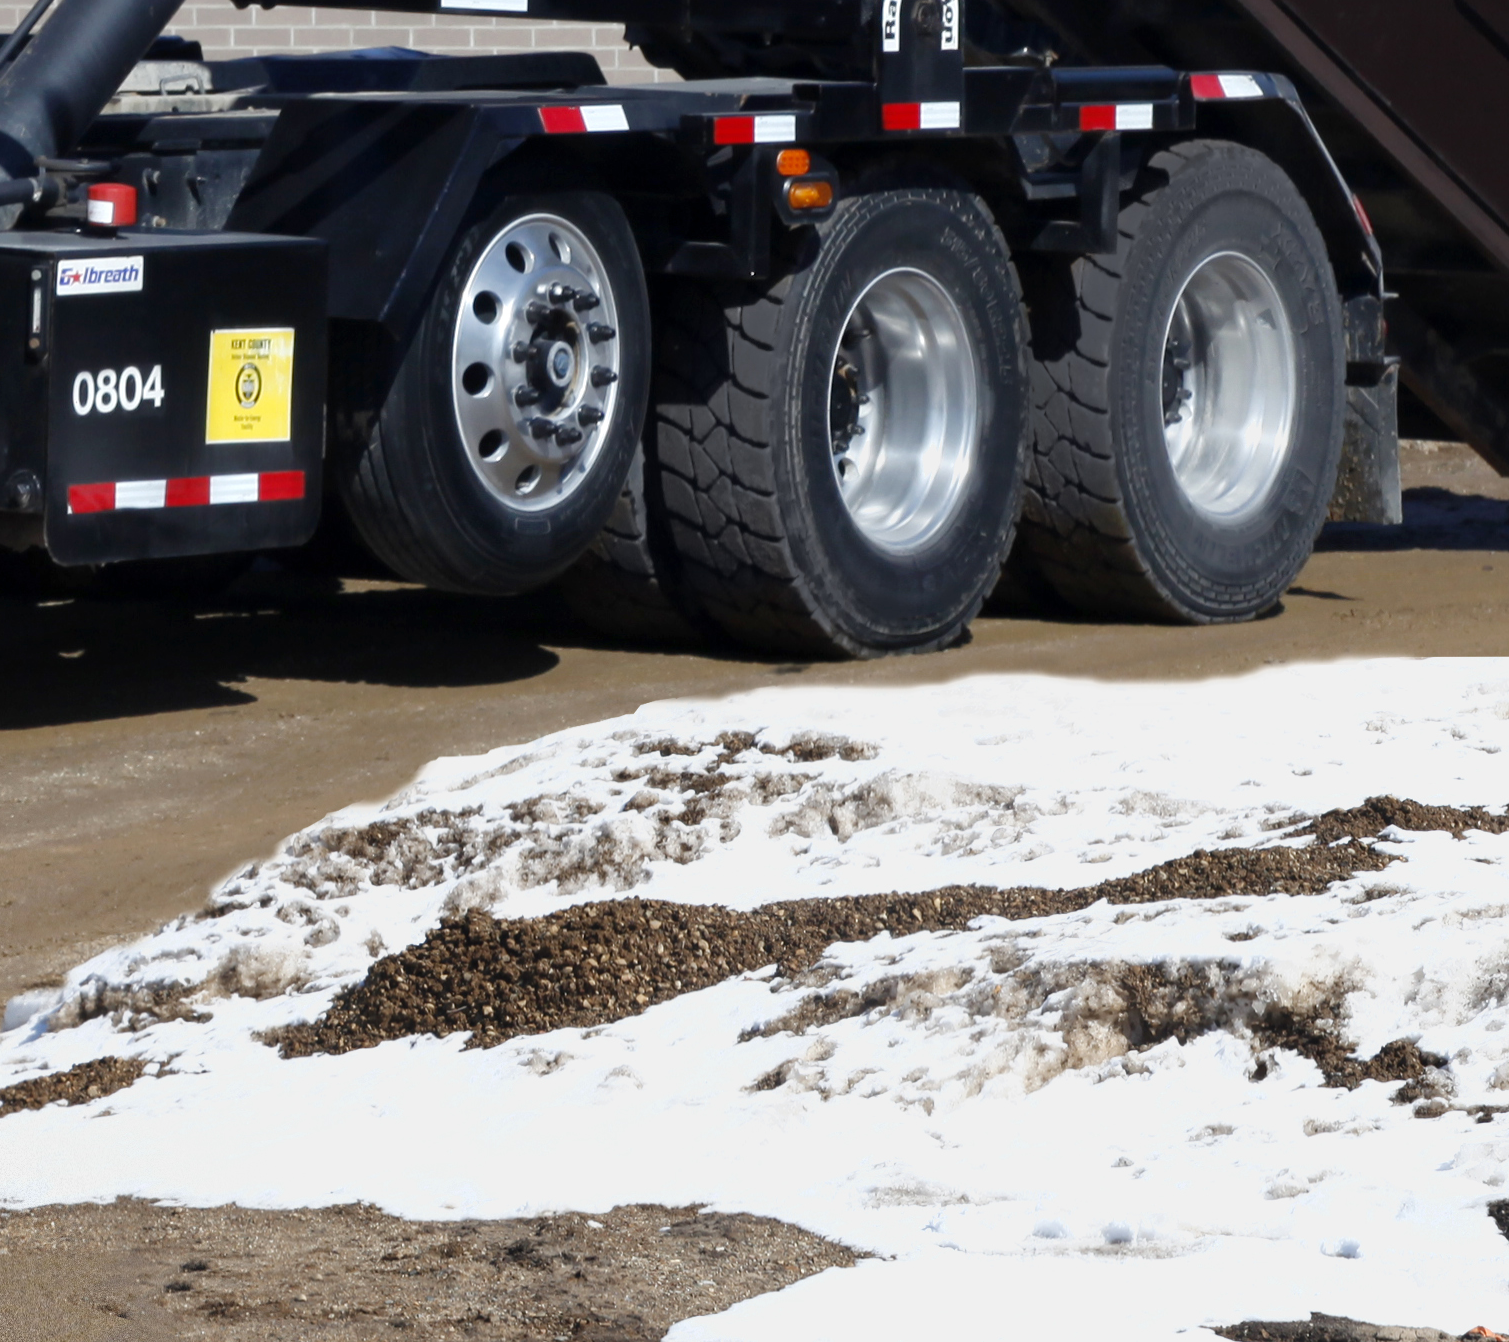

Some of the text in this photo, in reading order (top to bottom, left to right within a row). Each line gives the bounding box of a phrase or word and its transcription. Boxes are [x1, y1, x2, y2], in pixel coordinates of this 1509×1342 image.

[231, 338, 272, 350] KENT COUNTY
[72, 364, 165, 416] 0804
